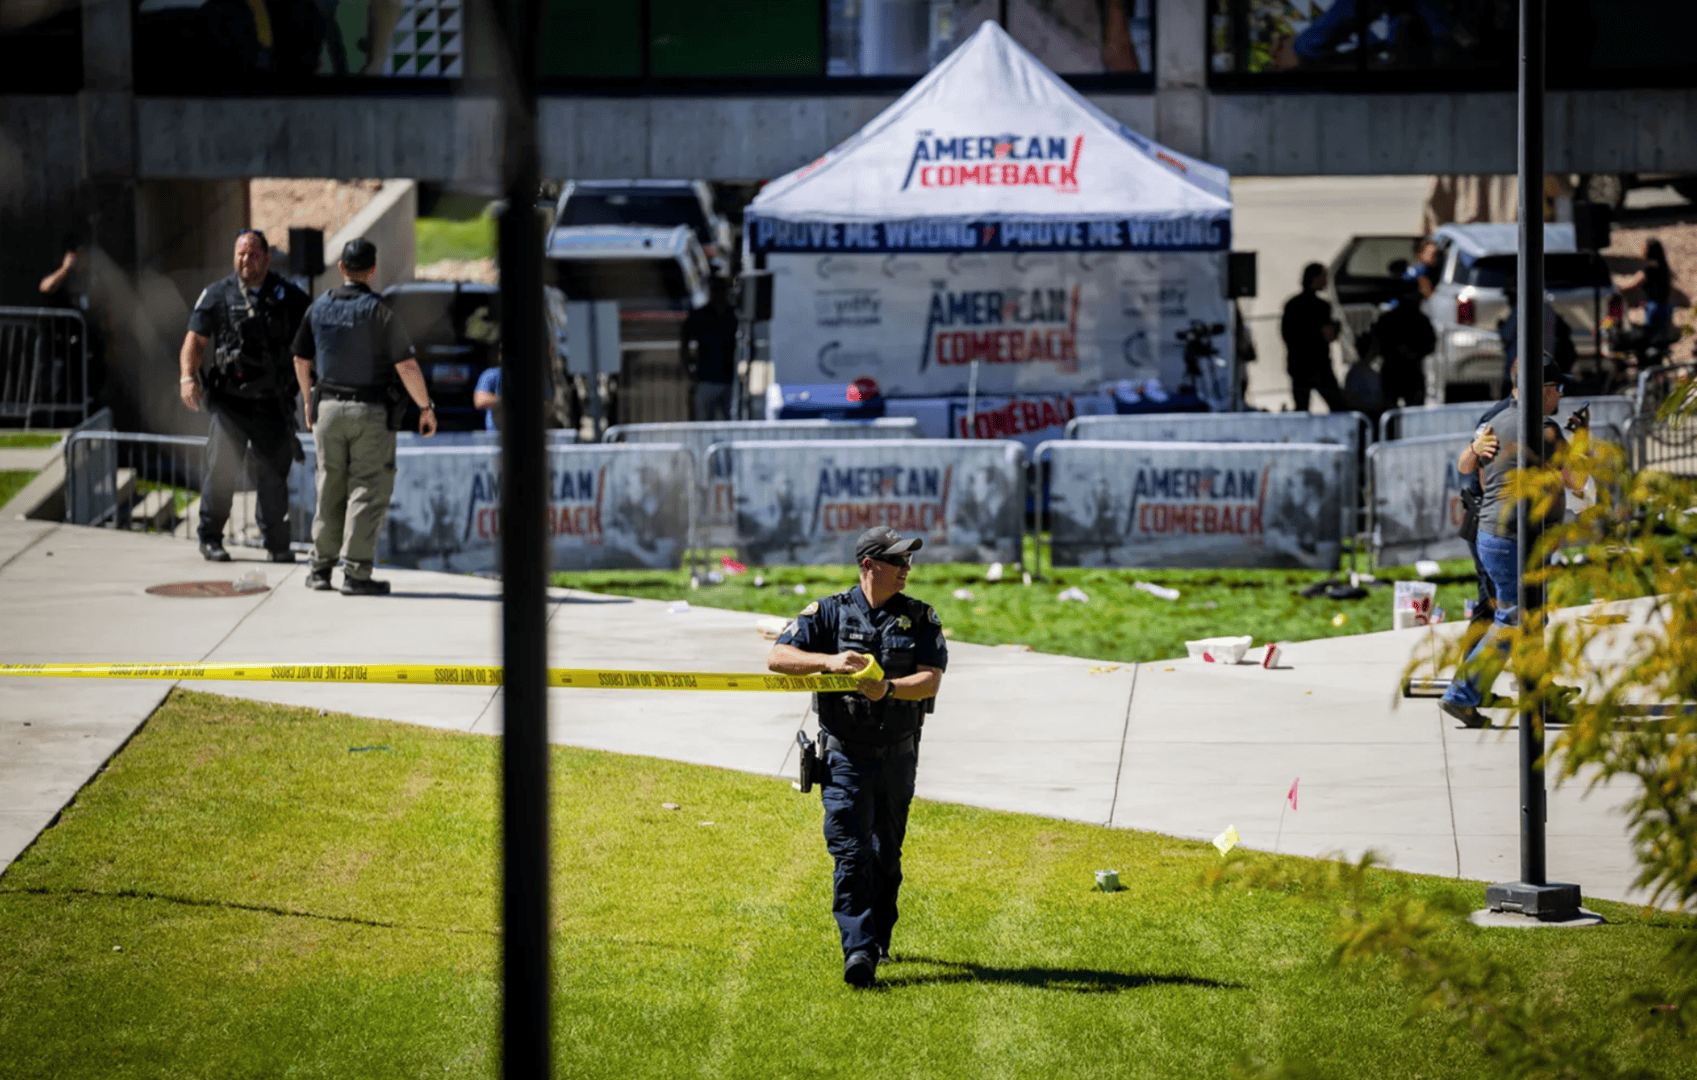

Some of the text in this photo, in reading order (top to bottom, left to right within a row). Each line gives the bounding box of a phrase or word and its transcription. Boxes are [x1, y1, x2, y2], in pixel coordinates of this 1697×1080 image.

[920, 163, 1078, 188] COMEBACK
[758, 219, 1222, 247] PROVE ME WRONG PROVE ME WRONG
[937, 329, 1076, 366] COMEBACK
[823, 503, 947, 532] COMEBACK
[1139, 503, 1264, 534] COMEBACK
[271, 666, 368, 680] POLICE LINE DO NOT CROSS
[434, 668, 458, 682] CROSS
[461, 668, 475, 682] NOT
[476, 668, 486, 683] DO
[598, 673, 698, 687] POLICE LINE DO NOT CROSS
